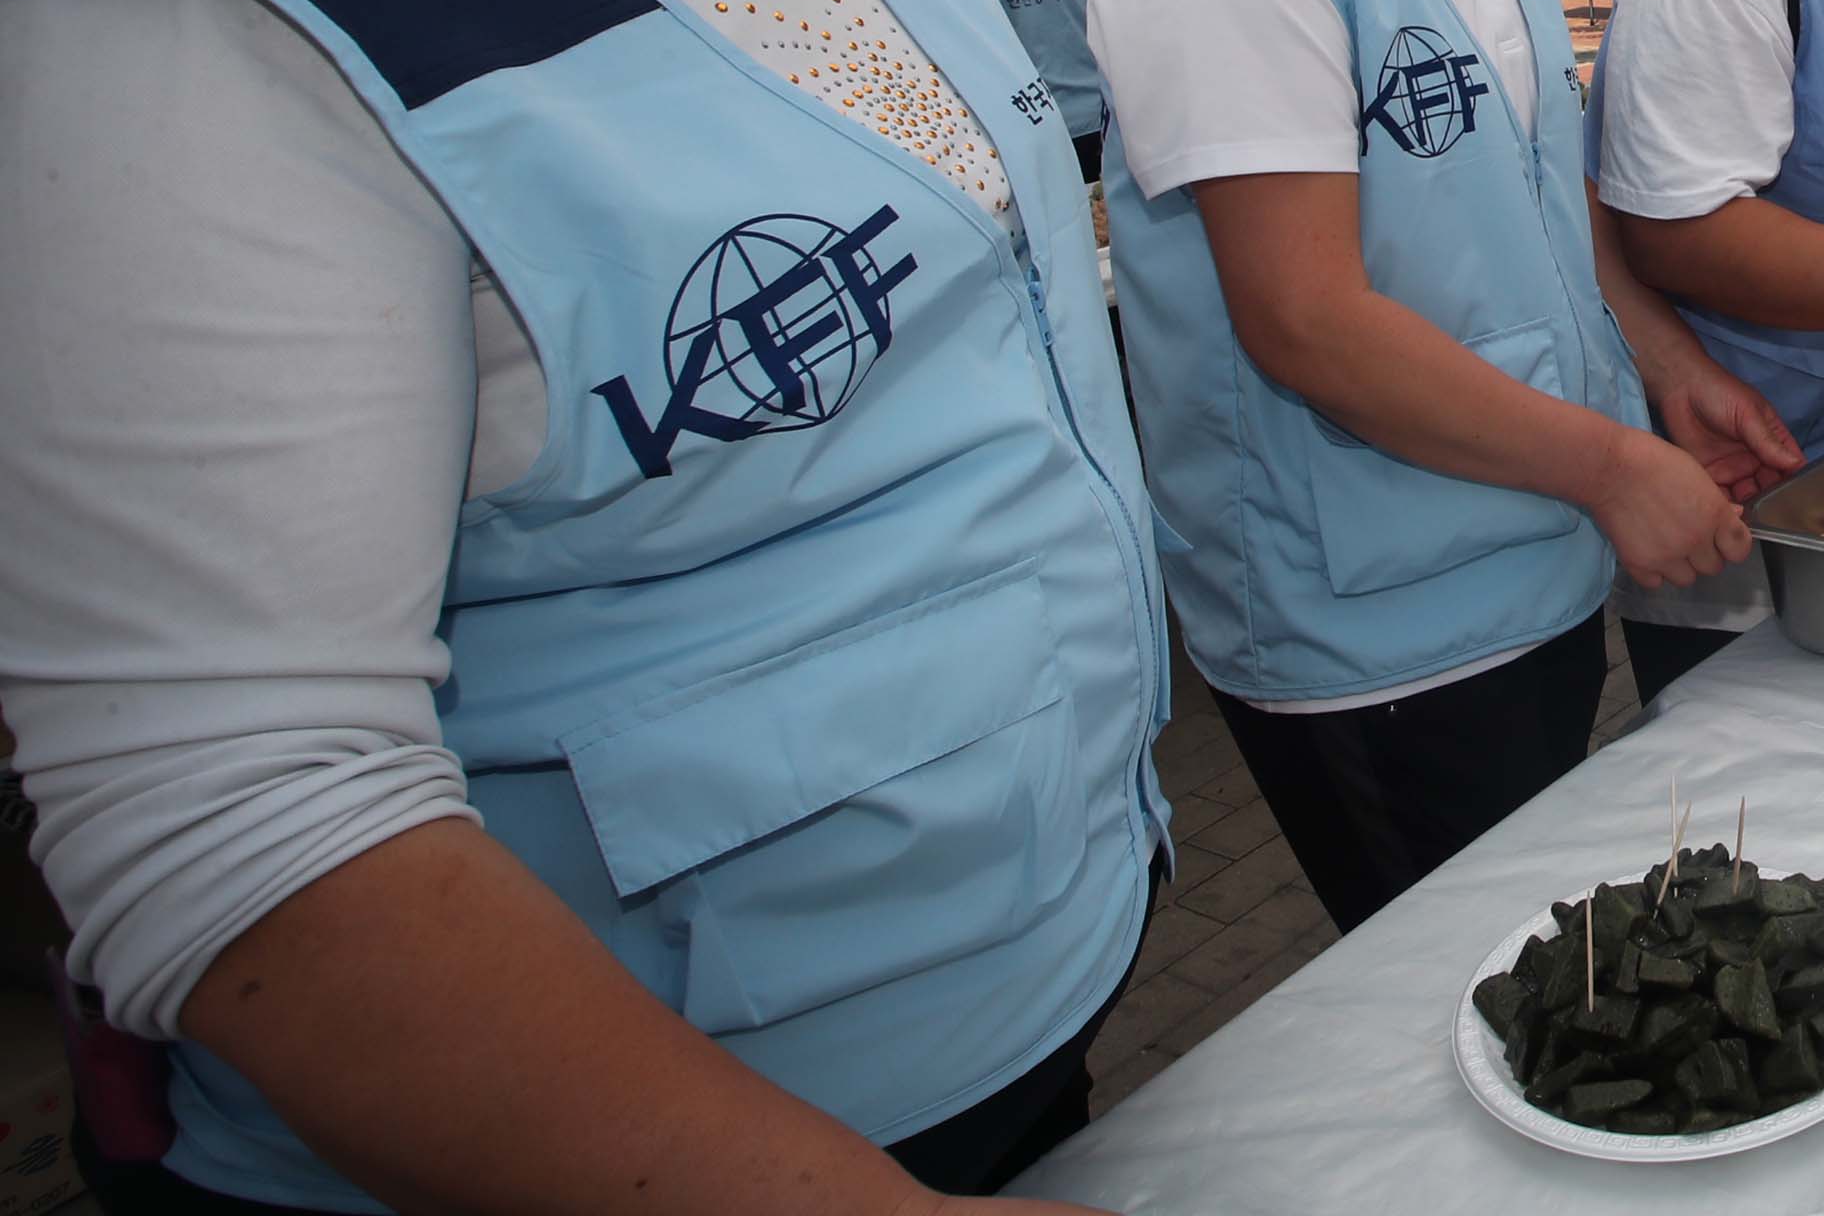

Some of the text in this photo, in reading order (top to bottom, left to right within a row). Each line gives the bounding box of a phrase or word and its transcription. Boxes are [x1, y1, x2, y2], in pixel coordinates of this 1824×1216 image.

[1010, 77, 1055, 126] 한국
[1359, 53, 1491, 158] KFF
[590, 204, 918, 480] KFF
